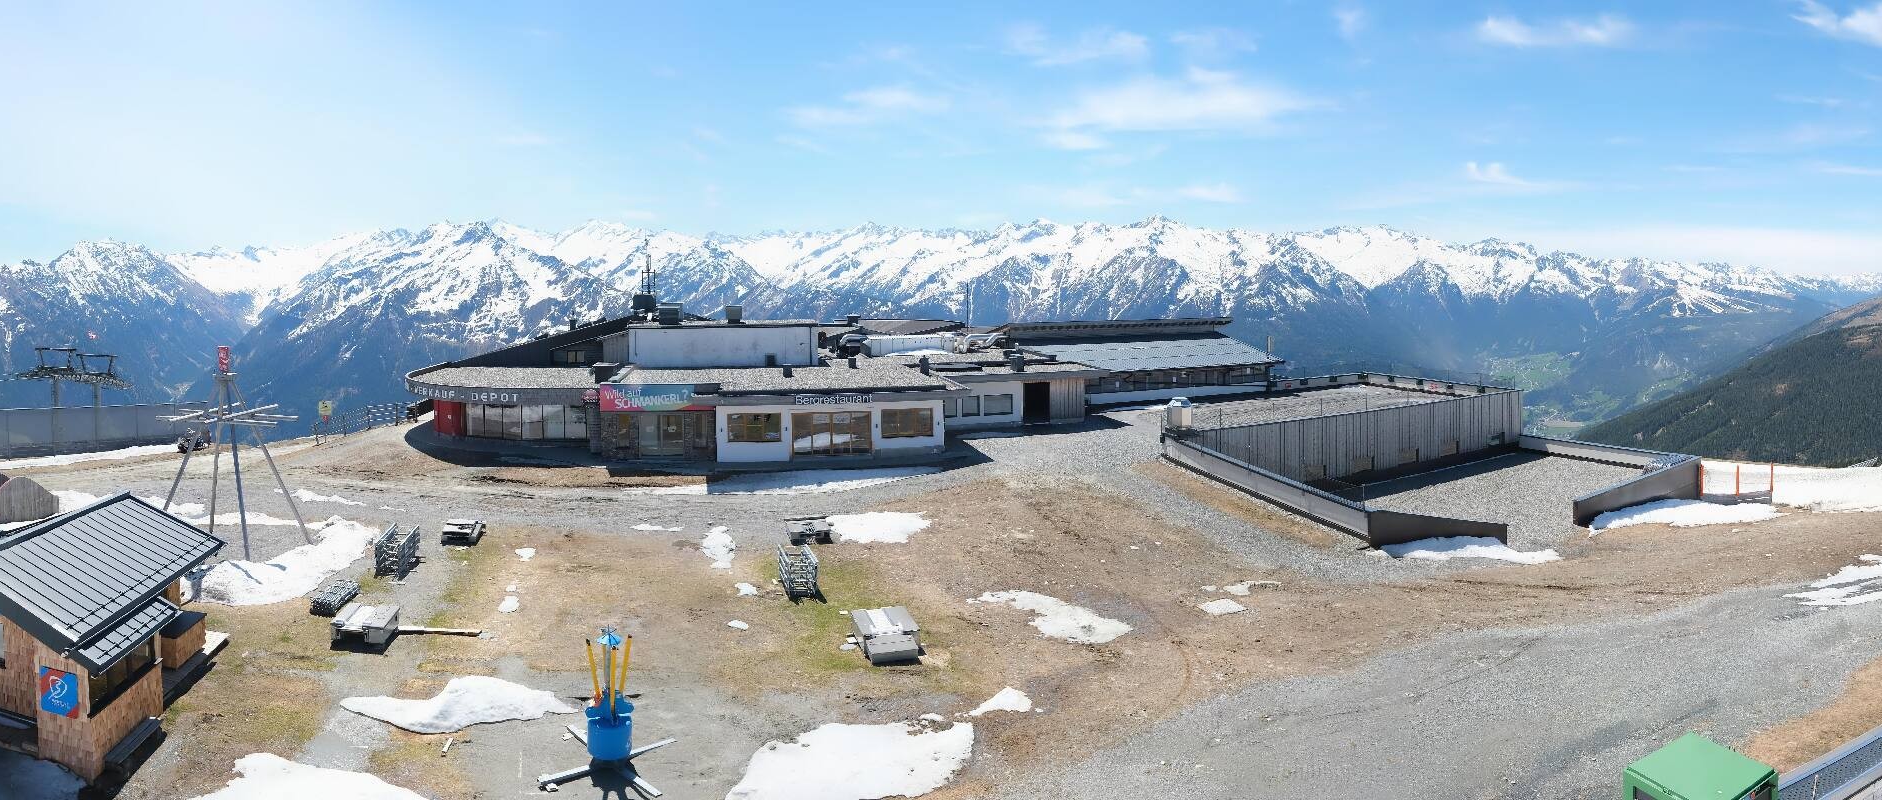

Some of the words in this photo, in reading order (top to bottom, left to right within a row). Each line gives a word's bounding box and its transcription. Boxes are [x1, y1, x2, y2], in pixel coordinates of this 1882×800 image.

[415, 386, 455, 399] VERKAUF
[471, 392, 519, 402] DEPOT
[604, 389, 625, 399] Wild
[627, 387, 642, 398] auf
[614, 389, 689, 409] SCHMANKERL?
